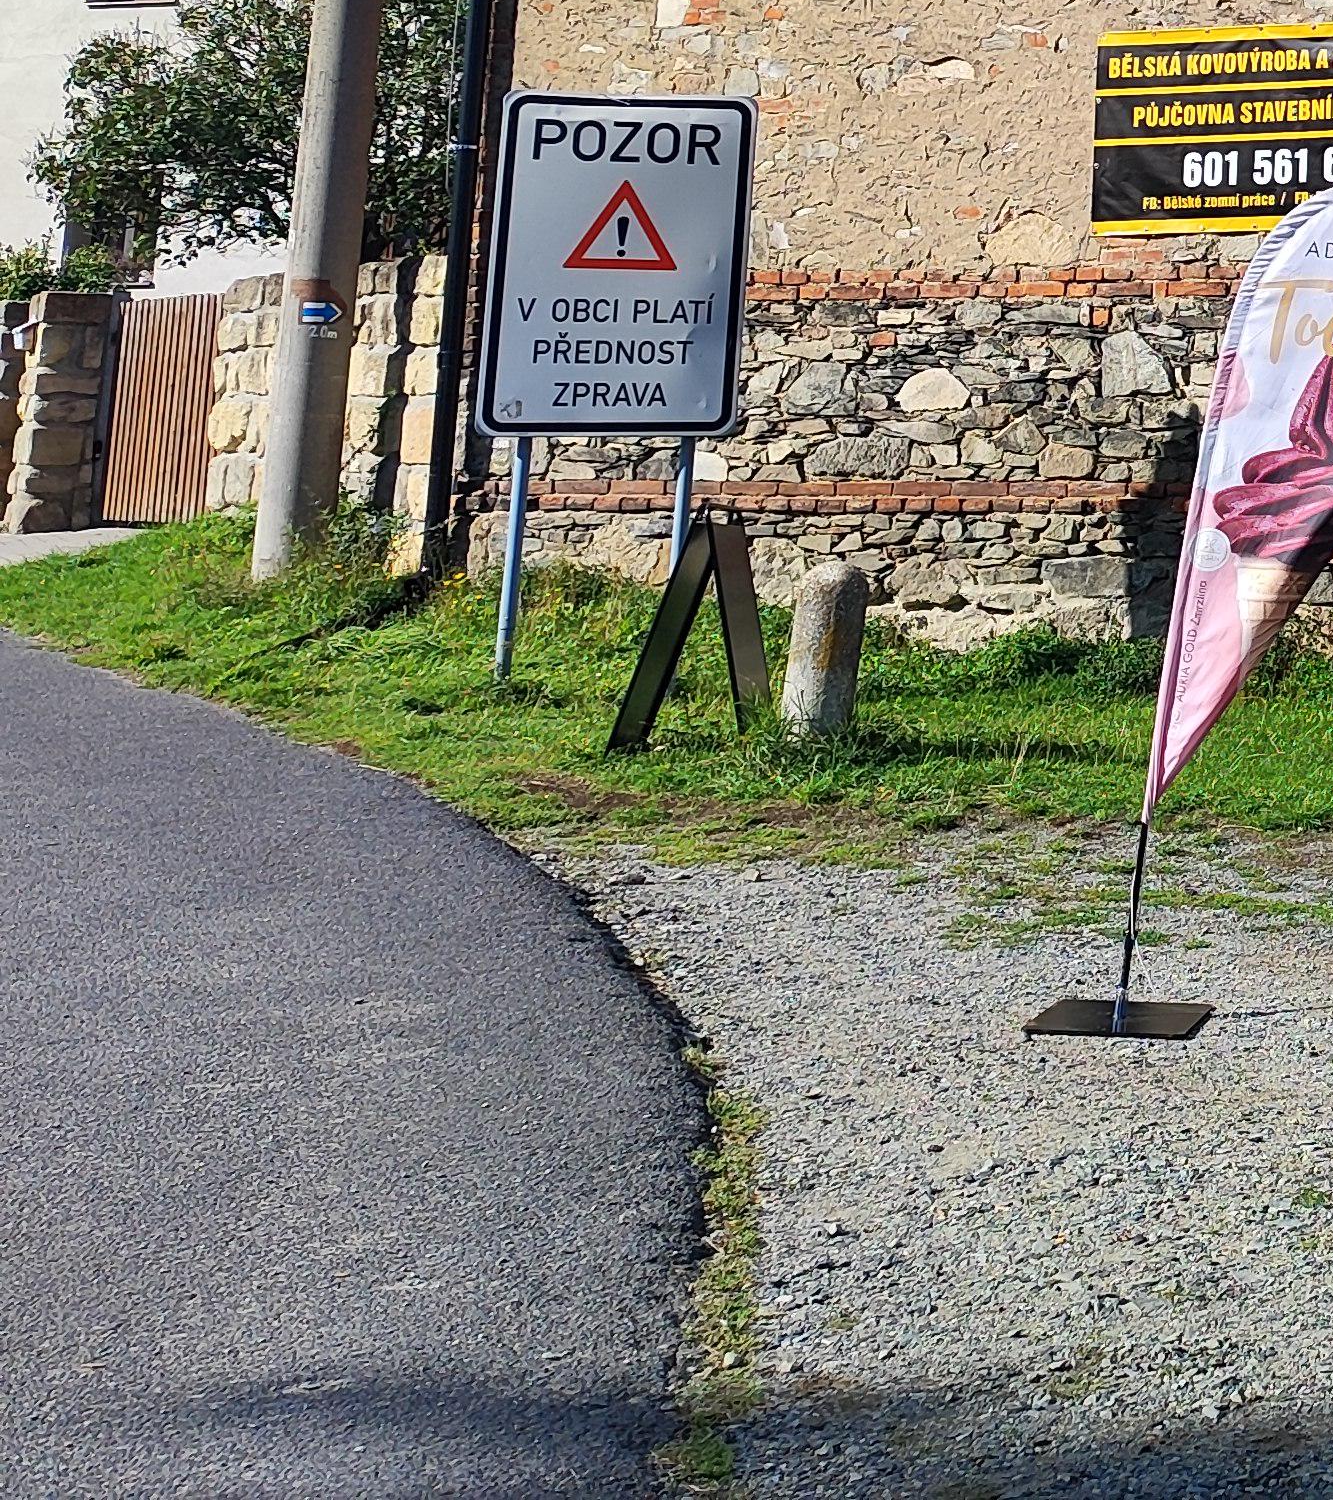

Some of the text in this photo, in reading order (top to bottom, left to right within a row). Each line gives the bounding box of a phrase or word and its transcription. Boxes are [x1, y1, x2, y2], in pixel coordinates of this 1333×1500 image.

[1108, 51, 1181, 79] BĚLSKÁ
[1187, 48, 1309, 76] KOVOVÝROBA
[1316, 49, 1328, 69] A
[1133, 101, 1235, 128] PŮJČOVNA
[532, 118, 722, 165] POZOR
[1183, 151, 1239, 188] 601
[1253, 147, 1309, 185] 561
[1242, 192, 1275, 208] práce
[517, 293, 715, 325] V OBCI PLATÍ
[532, 332, 695, 365] PŘEDNOST
[552, 382, 667, 407] ZPRAVA
[1183, 629, 1198, 663] GOLD
